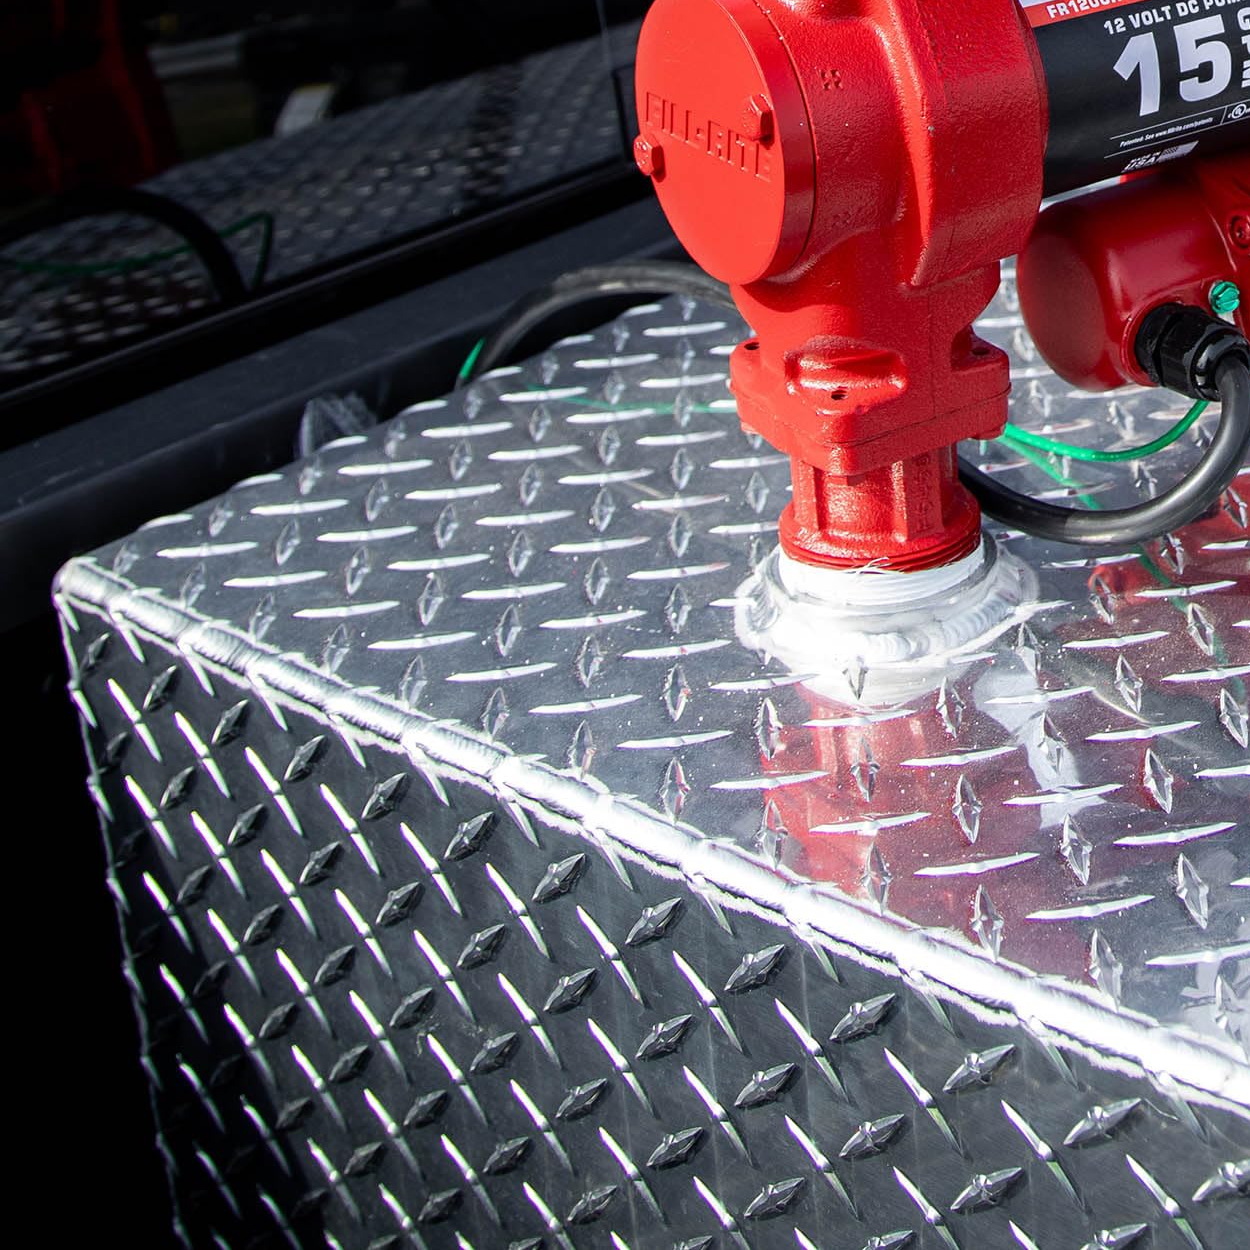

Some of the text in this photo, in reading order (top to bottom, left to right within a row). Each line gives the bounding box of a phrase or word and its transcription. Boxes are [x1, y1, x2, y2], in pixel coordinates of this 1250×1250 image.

[1103, 18, 1126, 36] 12
[1128, 5, 1173, 29] VOLT
[1113, 14, 1232, 117] 15
